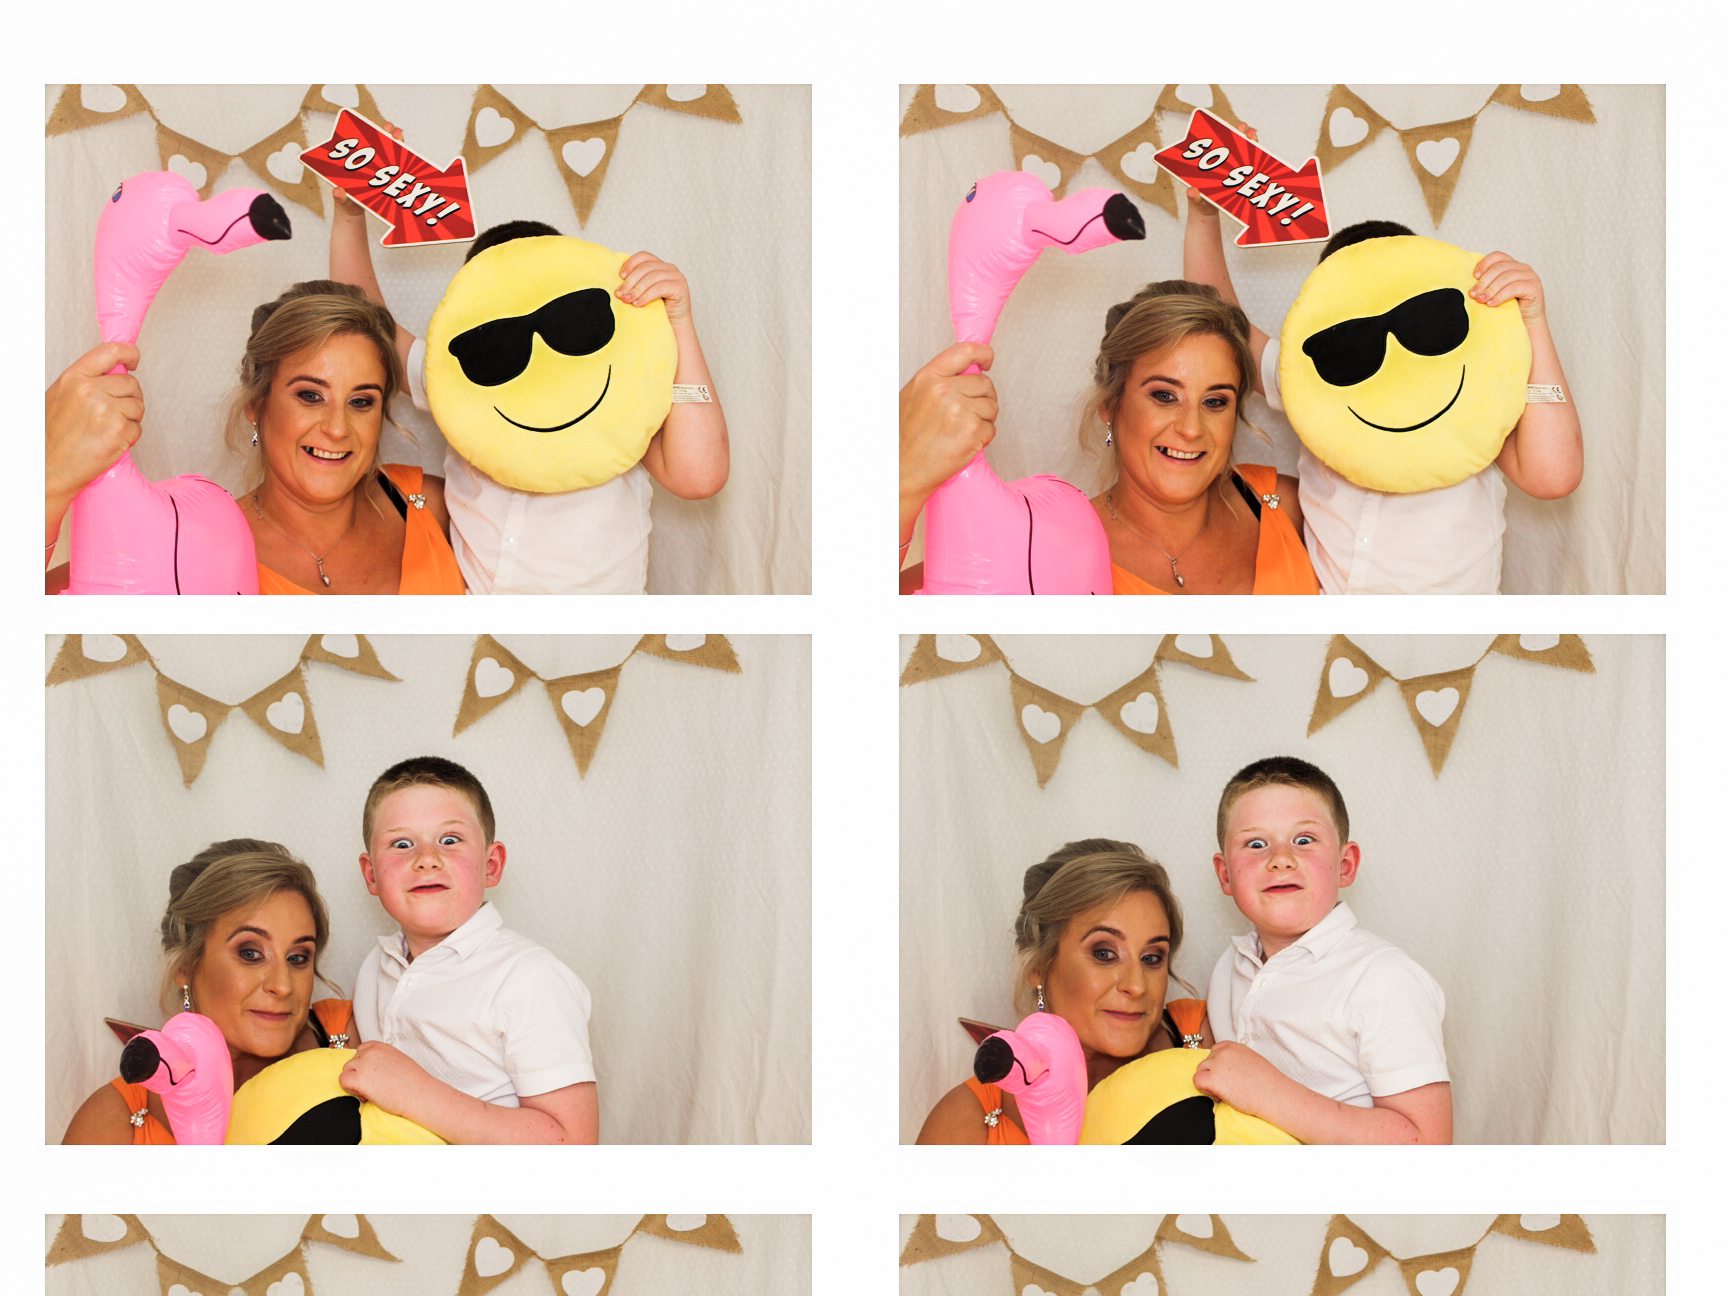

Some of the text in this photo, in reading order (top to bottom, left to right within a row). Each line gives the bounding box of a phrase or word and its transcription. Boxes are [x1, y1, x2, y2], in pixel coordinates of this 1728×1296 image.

[328, 138, 461, 226] SO SEXY!
[1182, 138, 1315, 226] SO SEXY!
